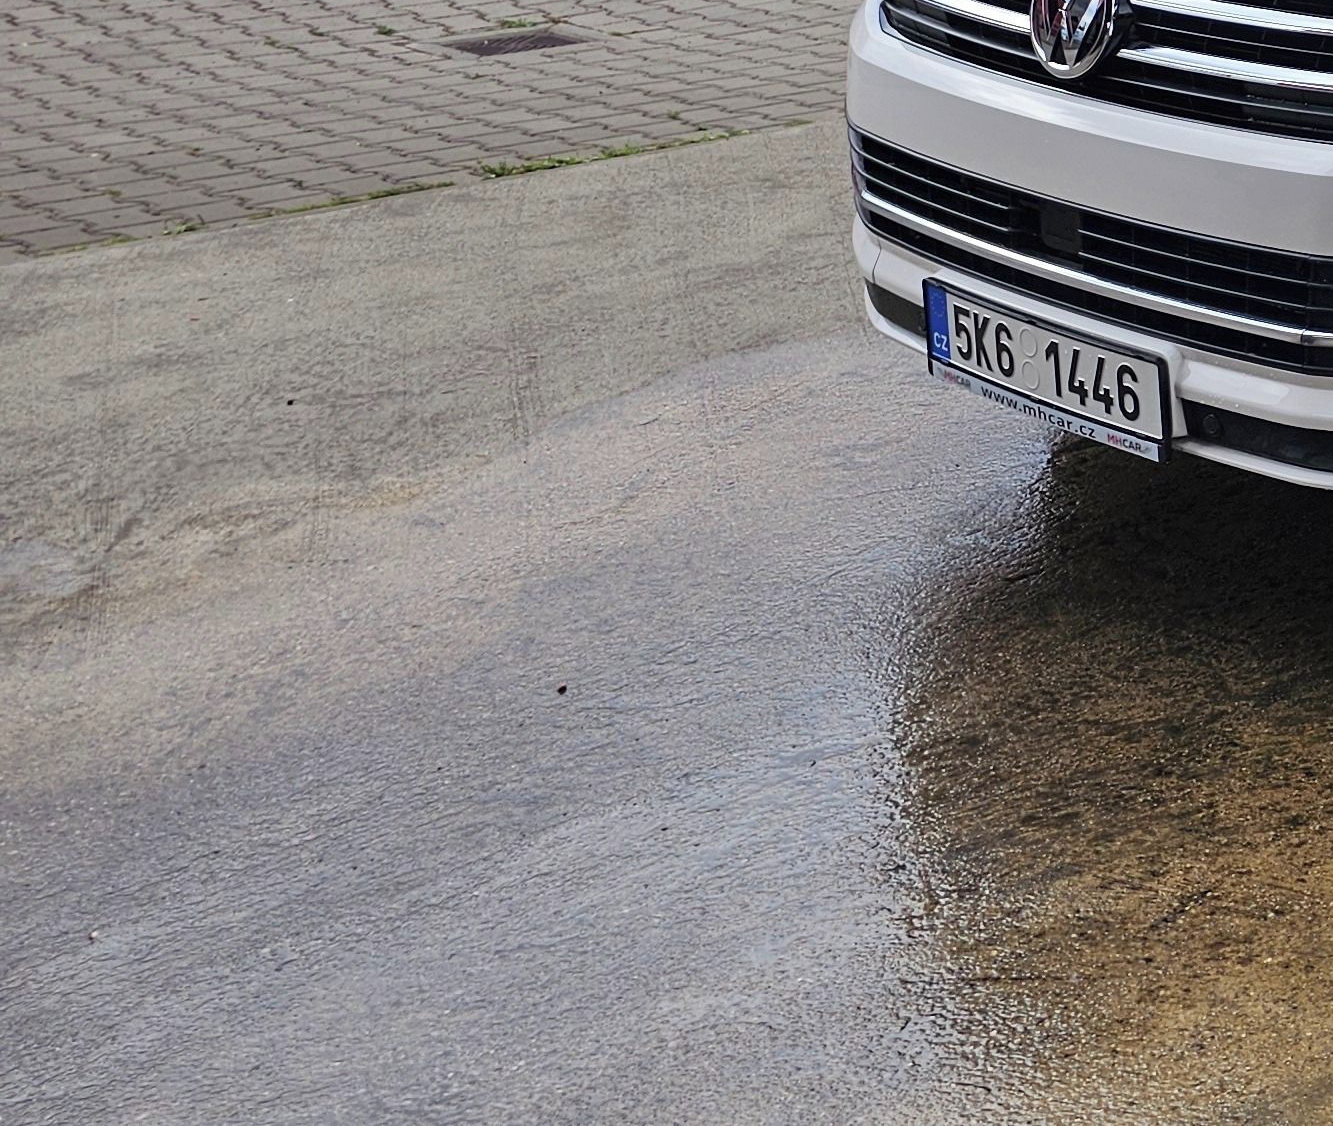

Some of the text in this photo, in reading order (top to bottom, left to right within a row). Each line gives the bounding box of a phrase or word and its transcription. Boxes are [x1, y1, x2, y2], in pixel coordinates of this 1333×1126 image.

[933, 303, 1141, 422] CZ 5K6 1446
[980, 385, 1097, 440] www.mhcar.cz
